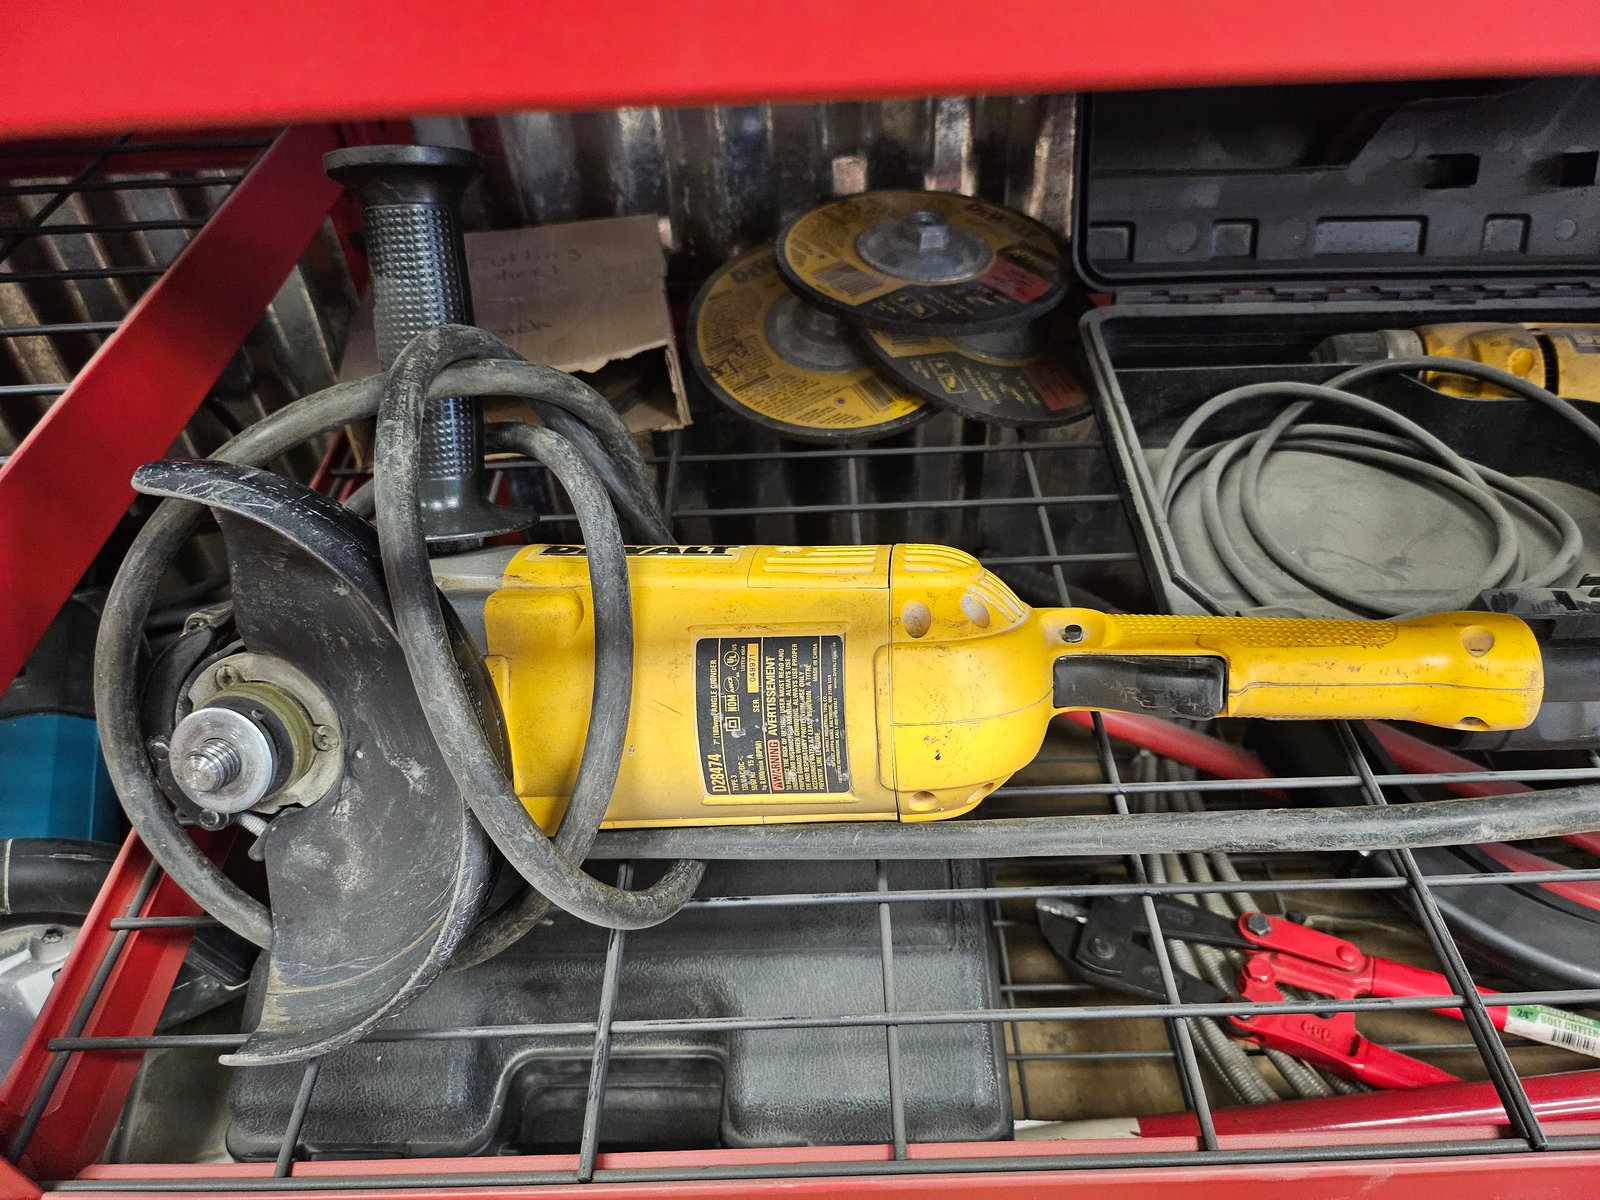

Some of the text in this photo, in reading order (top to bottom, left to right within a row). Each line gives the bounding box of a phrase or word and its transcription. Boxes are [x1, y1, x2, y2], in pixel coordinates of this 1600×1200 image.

[540, 546, 739, 555] DWALT
[727, 654, 736, 663] UL
[710, 690, 718, 712] ANGLE
[727, 695, 737, 712] NOM
[752, 698, 760, 712] SER.
[766, 656, 782, 782] WARNING AVERTISSEMENT
[755, 740, 764, 759] (RPM)
[781, 737, 787, 745] OF
[801, 739, 810, 772] RESPIRATORY
[708, 754, 727, 792] D28474
[1541, 1014, 1562, 1029] BOLT
